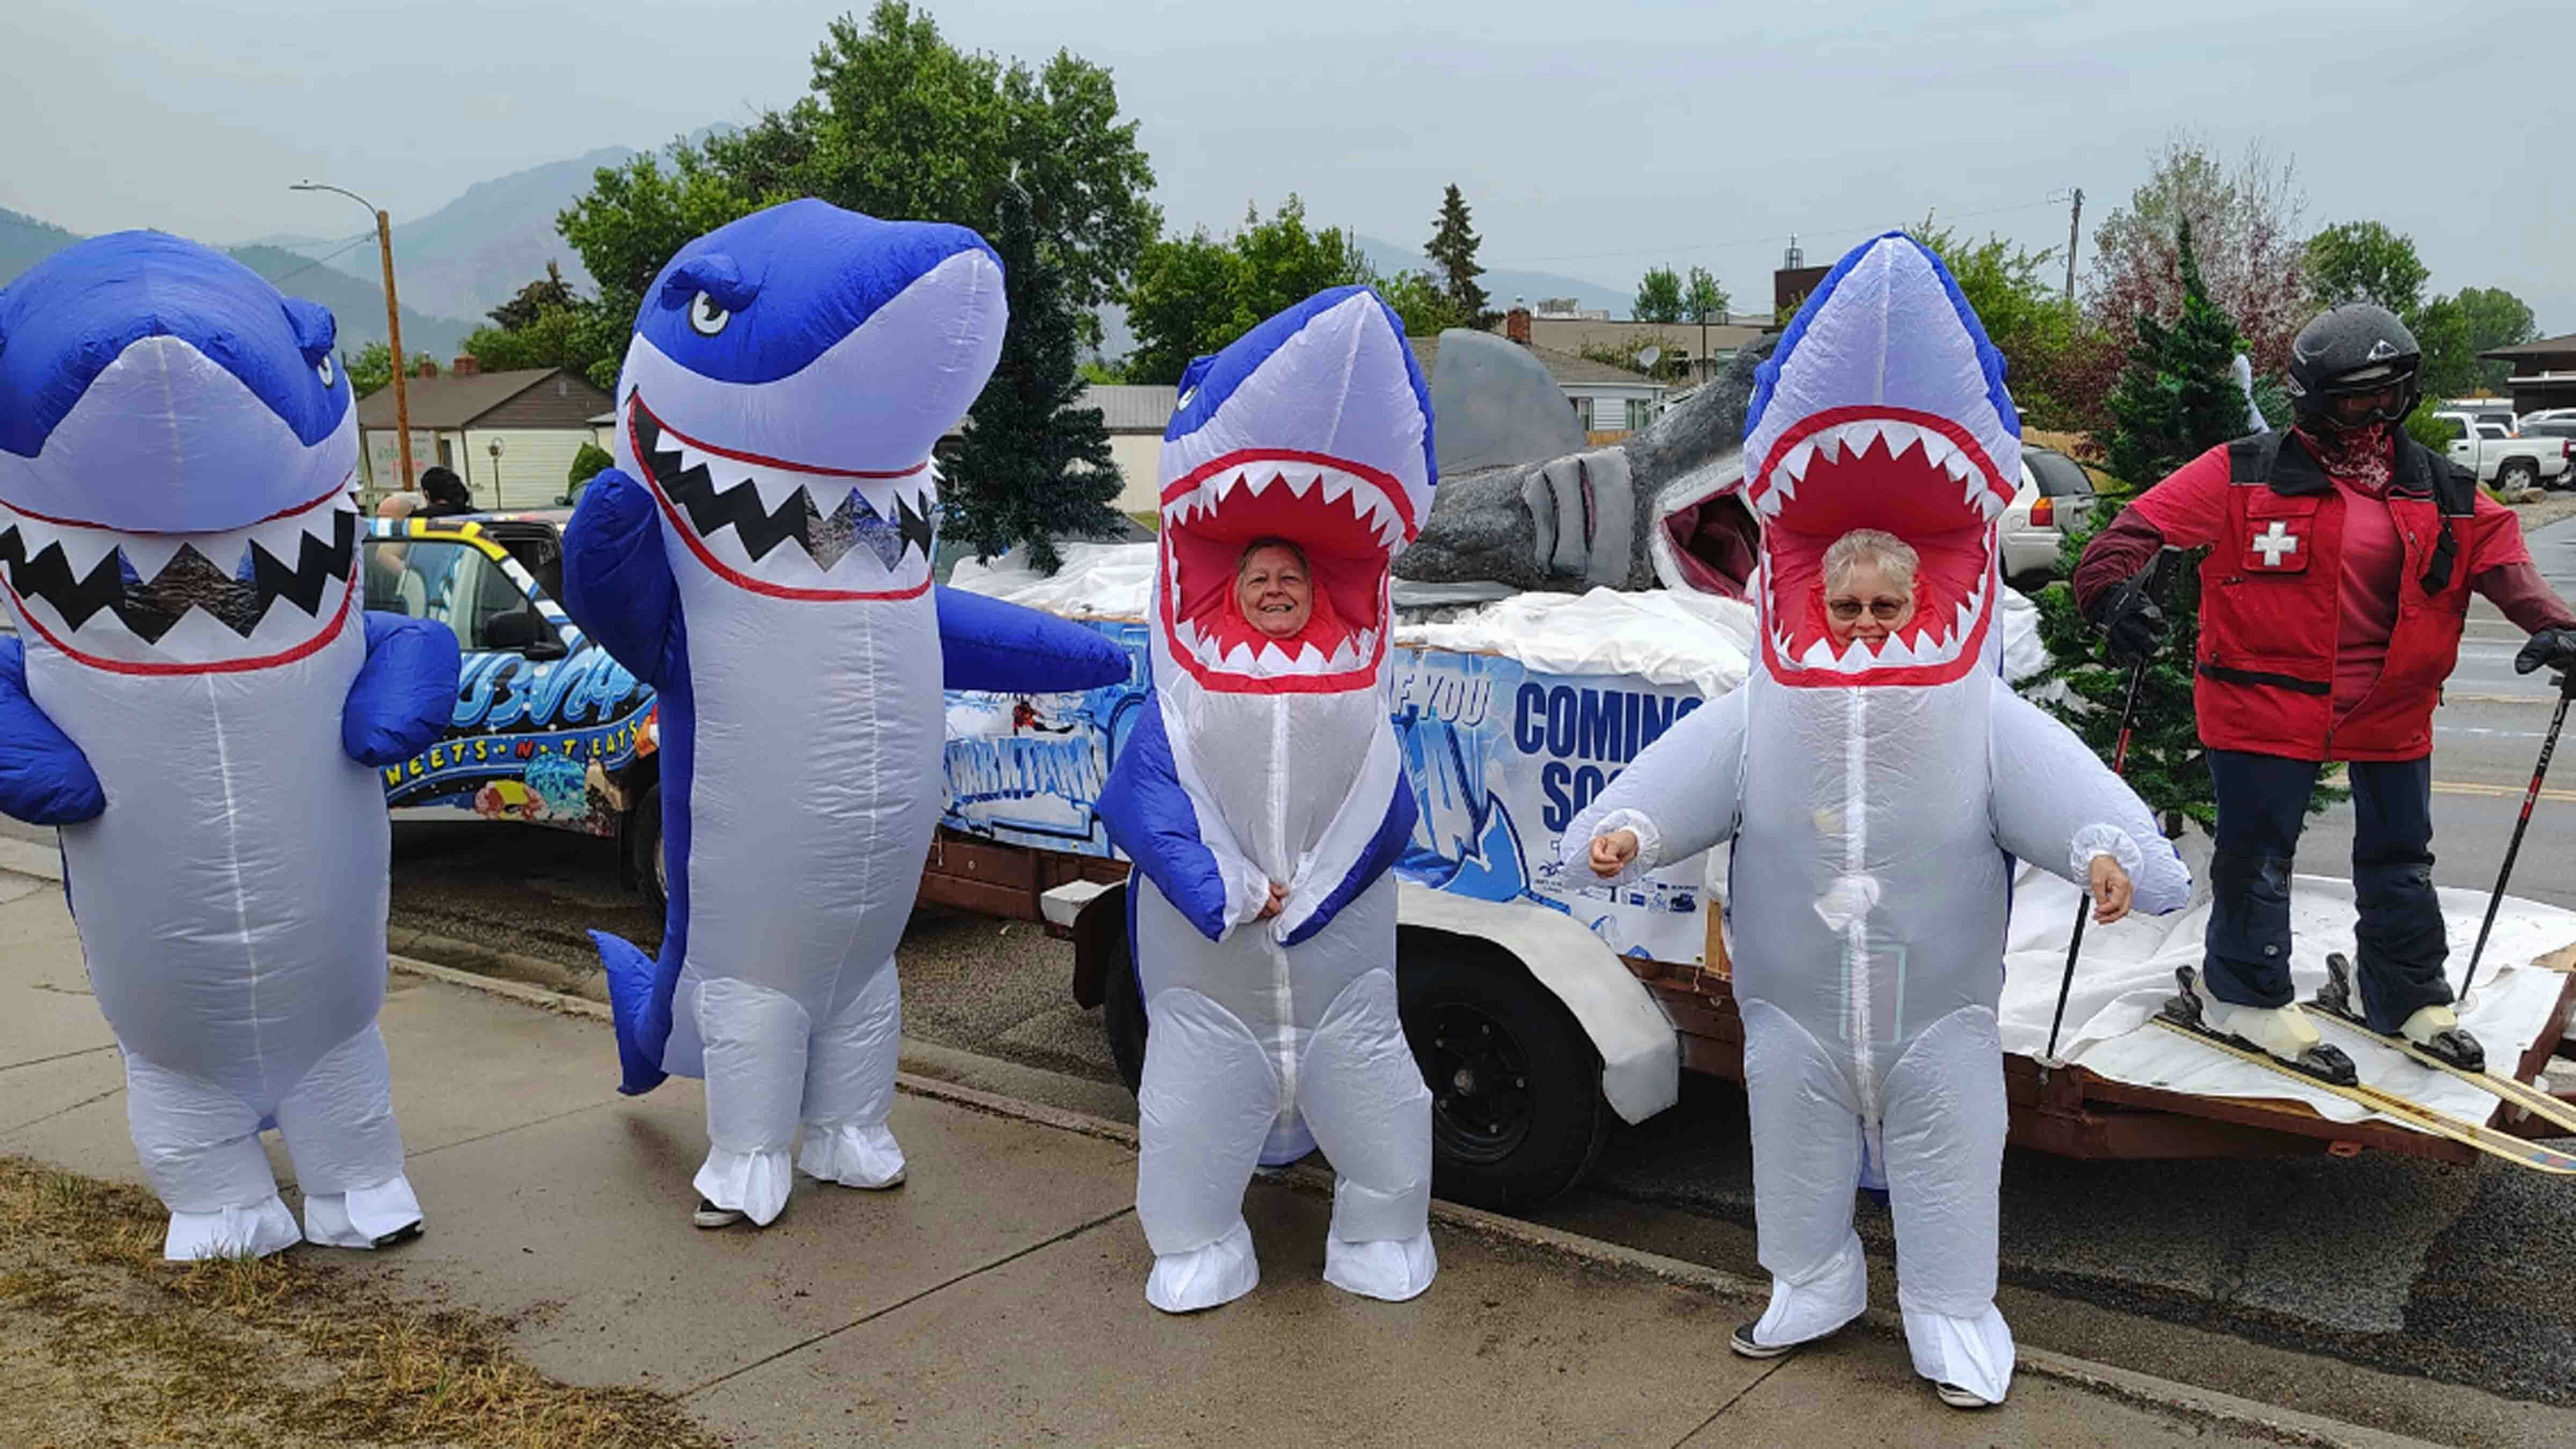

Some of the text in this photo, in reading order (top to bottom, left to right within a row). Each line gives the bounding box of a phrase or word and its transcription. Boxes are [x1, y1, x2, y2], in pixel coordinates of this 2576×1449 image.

[1390, 671, 1492, 727] F YOU
[1514, 682, 1704, 763] COMIN
[385, 719, 639, 787] WEETS N TEATS
[1541, 762, 1624, 833] SO
